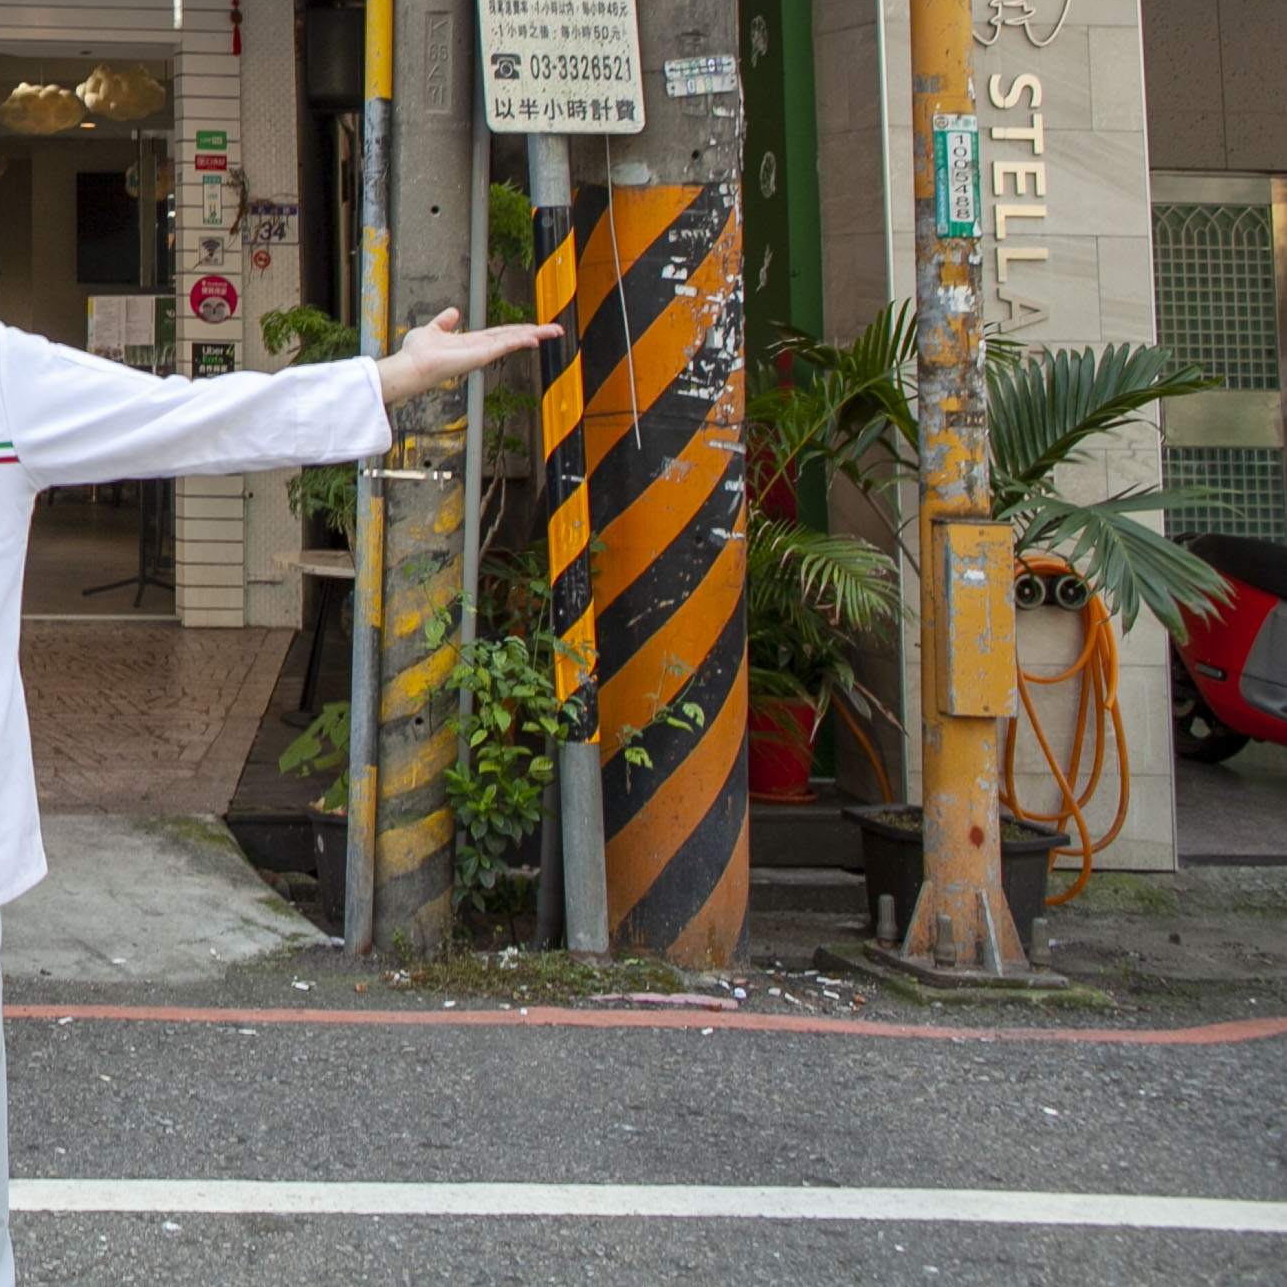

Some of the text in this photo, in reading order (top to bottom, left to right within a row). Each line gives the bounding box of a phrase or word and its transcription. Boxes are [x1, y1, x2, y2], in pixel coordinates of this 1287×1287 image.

[530, 53, 632, 82] 03-3326521
[495, 96, 635, 121] 以半小時計費
[258, 220, 286, 242] 34
